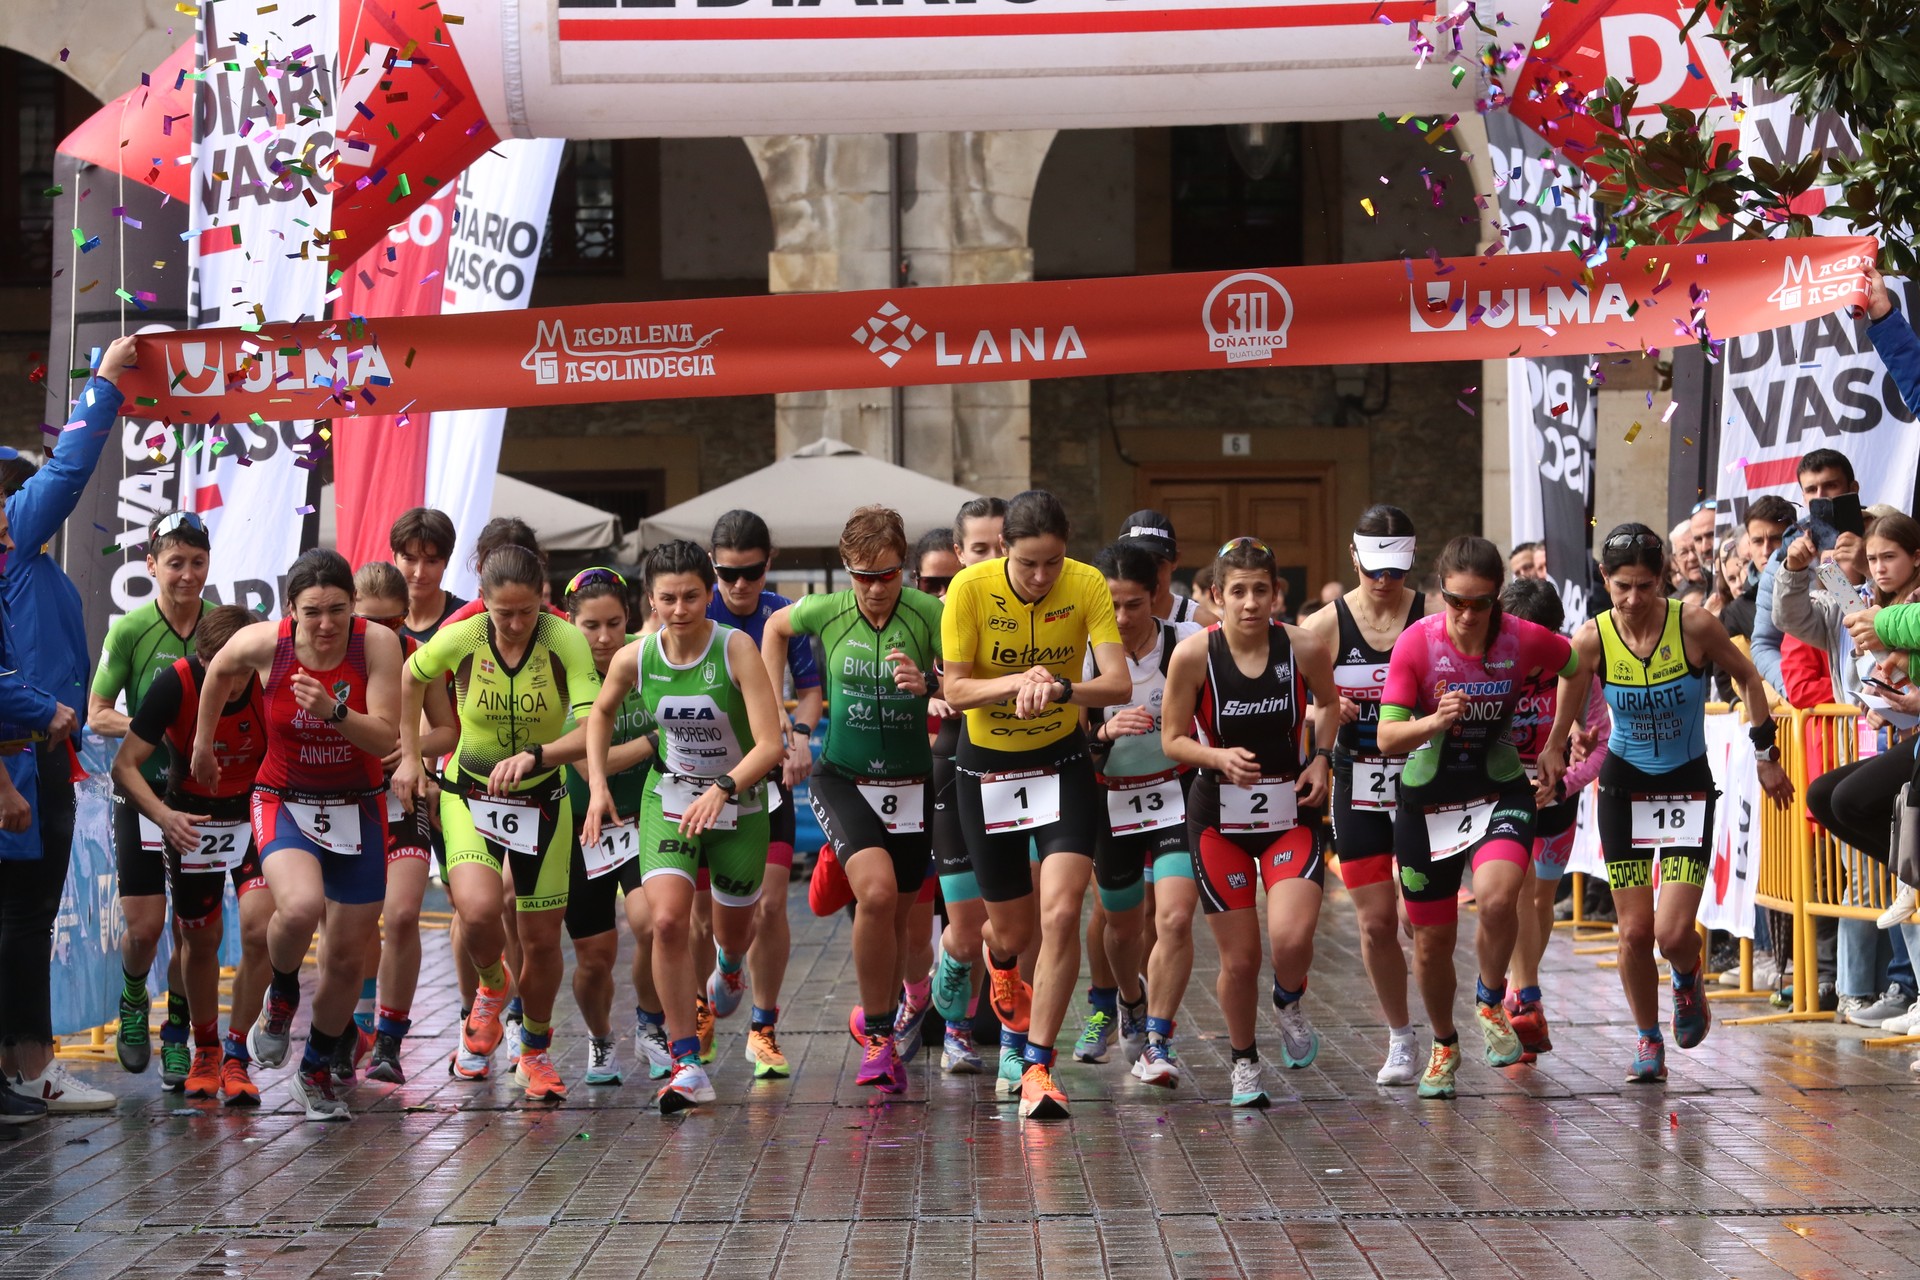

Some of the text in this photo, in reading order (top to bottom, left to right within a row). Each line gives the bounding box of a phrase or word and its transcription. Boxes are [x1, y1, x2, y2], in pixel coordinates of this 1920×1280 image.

[1228, 292, 1268, 333] 30
[1479, 283, 1635, 328] ULMA
[936, 326, 1087, 366] LANA
[1214, 335, 1283, 348] OÑATIKO
[1229, 349, 1271, 359] DUATLOIA
[234, 343, 394, 393] ULMA
[990, 618, 1017, 630] PTO
[1447, 680, 1512, 697] SALTOKI
[1616, 685, 1686, 711] URIARTE
[477, 689, 547, 713] AINHOA
[1221, 694, 1289, 716] Santini
[485, 714, 541, 723] TRIATHLON
[664, 707, 715, 720] LEA
[670, 726, 722, 742] MORENO
[990, 721, 1062, 737] orca
[300, 744, 352, 765] AINHIZE
[881, 794, 898, 815] 8
[1014, 786, 1029, 809] 1
[1128, 792, 1164, 814] 13
[1250, 793, 1269, 814] 2
[313, 813, 331, 834] 5
[487, 811, 519, 834] 16
[1457, 814, 1473, 835] 4
[1652, 808, 1686, 829] 18
[200, 833, 235, 855] 22
[657, 839, 697, 859] BH
[448, 853, 499, 870] TRIATHLON
[714, 873, 755, 896] BH
[1609, 861, 1649, 889] SOPELA
